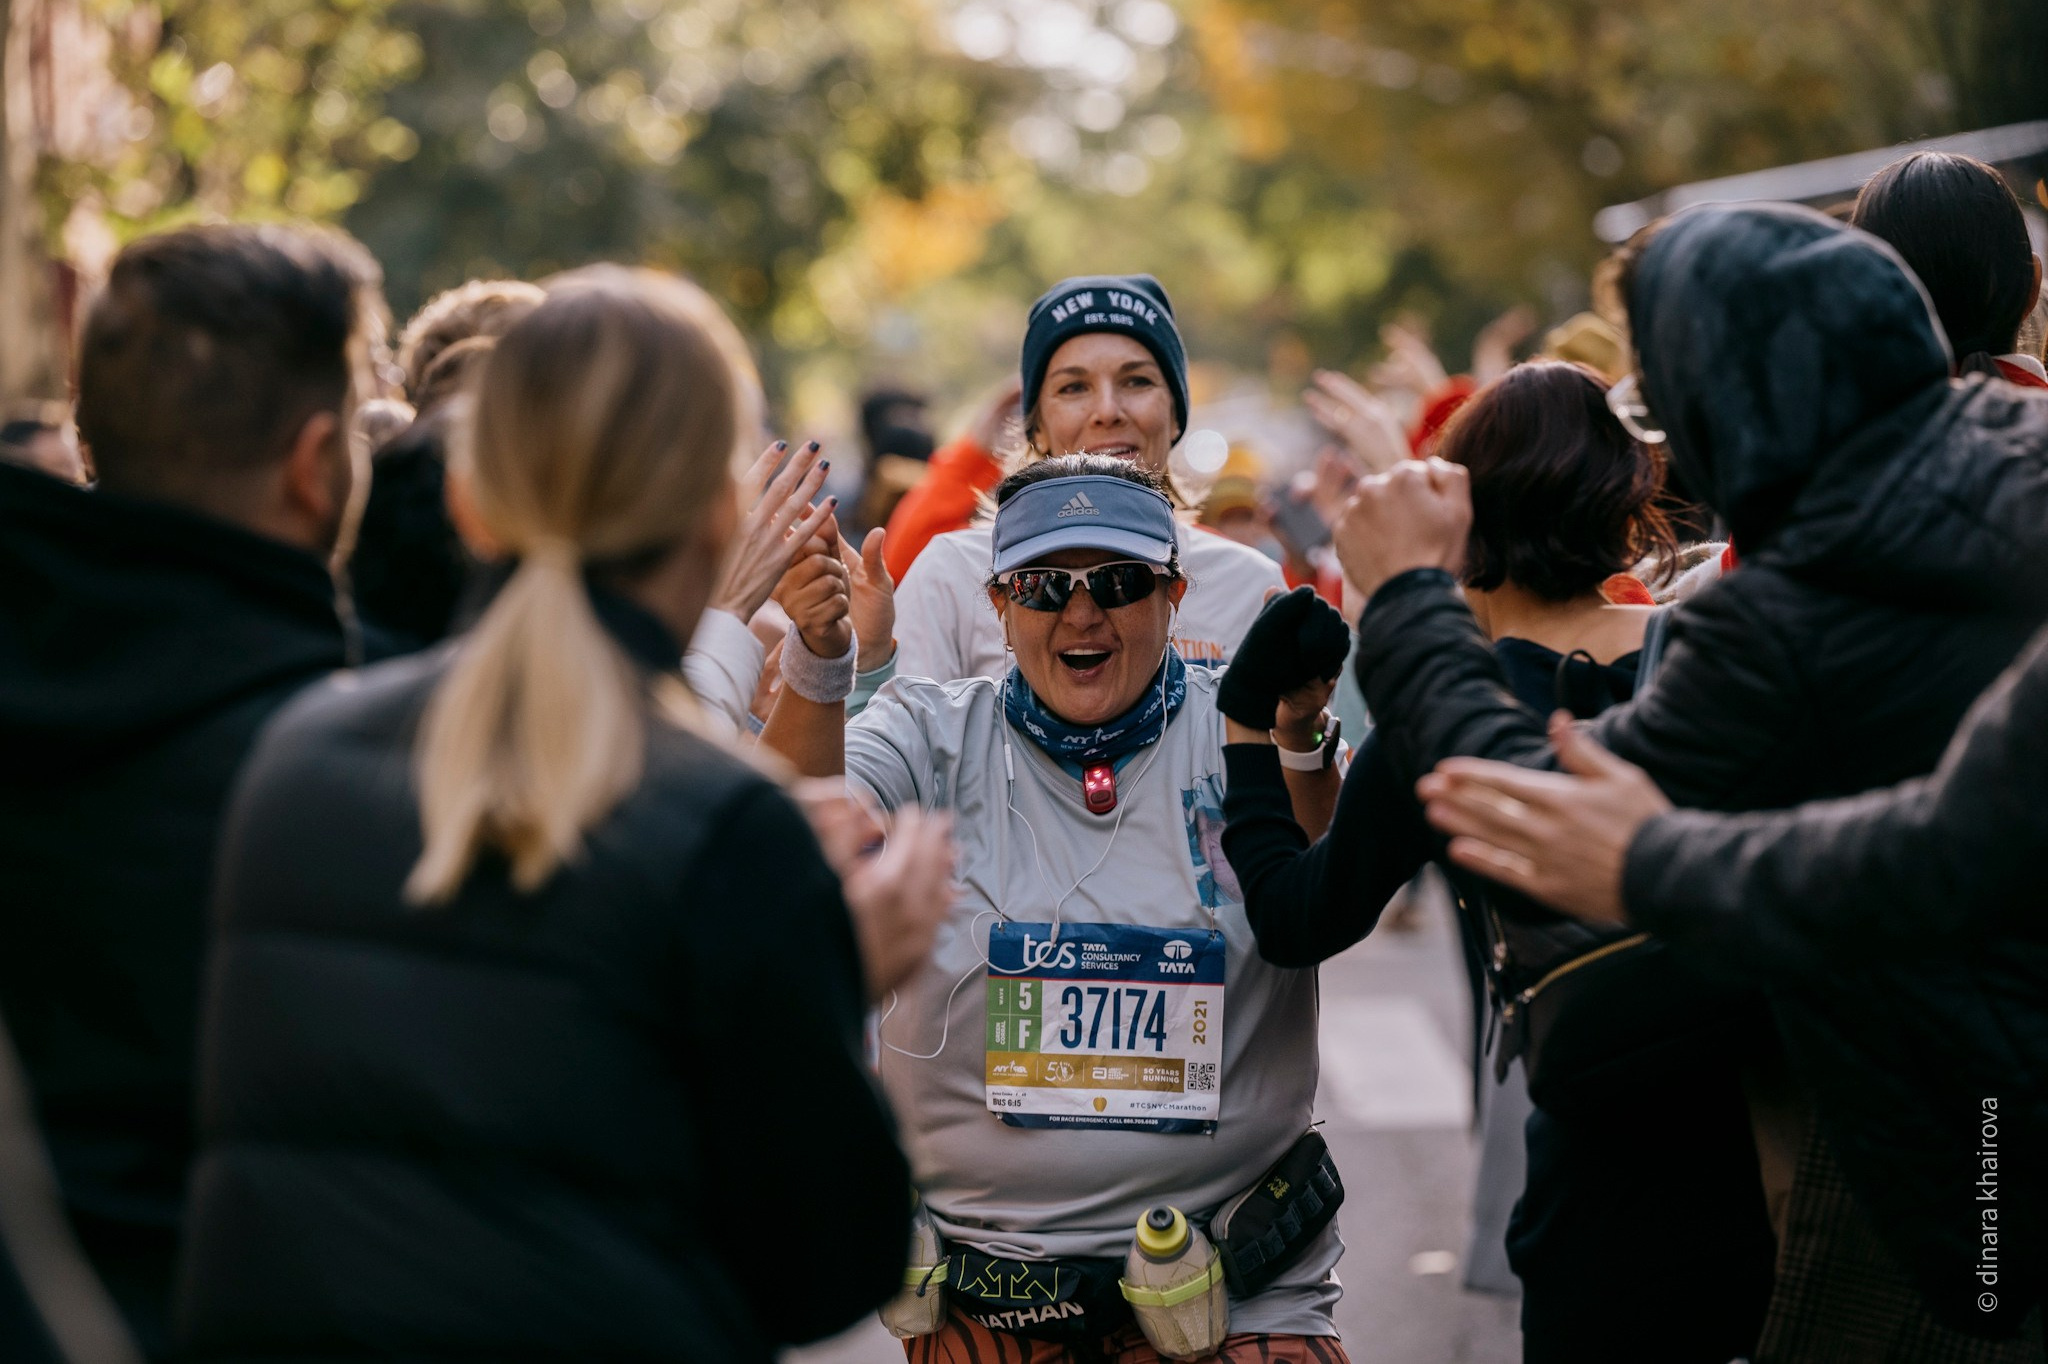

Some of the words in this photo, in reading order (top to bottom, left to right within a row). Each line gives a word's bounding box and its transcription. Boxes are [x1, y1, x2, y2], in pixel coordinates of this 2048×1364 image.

[1051, 291, 1094, 324] NEW
[1107, 291, 1158, 326] YORK
[1057, 504, 1100, 518] adidas
[1023, 934, 1076, 969] tcs
[1082, 943, 1107, 952] TATA
[1081, 952, 1141, 962] CONSULTANCY
[1081, 962, 1119, 970] SERVICES
[1158, 962, 1195, 974] TATA
[1019, 982, 1032, 1010] 5
[1060, 985, 1167, 1051] 37174
[1193, 1000, 1208, 1045] 2021
[1019, 1019, 1031, 1049] F
[1156, 1068, 1179, 1077] YEARS
[1143, 1075, 1180, 1083] RUNNING
[993, 1098, 1006, 1106] BUS
[1130, 1102, 1207, 1111] #TCSNYCMarathon
